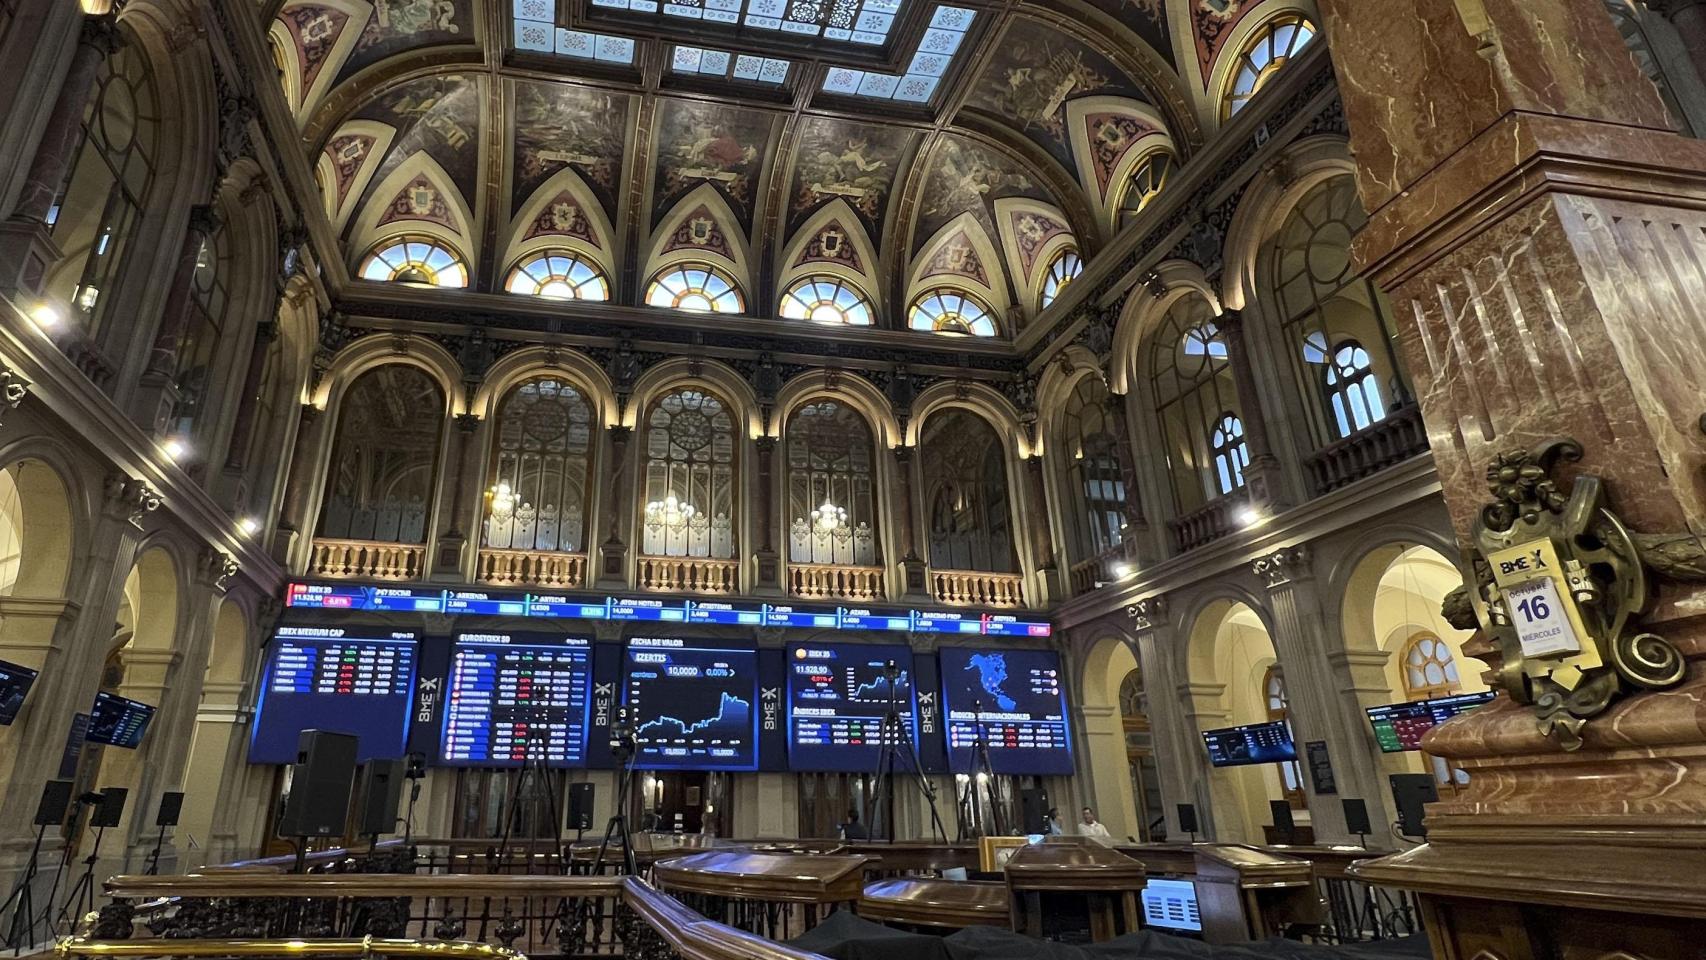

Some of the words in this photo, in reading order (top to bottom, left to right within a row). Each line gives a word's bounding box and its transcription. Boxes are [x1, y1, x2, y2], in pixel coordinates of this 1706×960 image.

[1500, 556, 1530, 574] BME
[1509, 583, 1548, 598] OCTUBRE
[1517, 595, 1550, 622] 16
[279, 627, 297, 636] IBEX
[297, 628, 328, 637] MEDIUM
[329, 629, 345, 638] CAP
[460, 633, 501, 643] EUROSTOXX
[630, 638, 651, 646] FICHA
[662, 639, 684, 647] VALOR
[418, 693, 433, 722] BME
[595, 698, 608, 726] BME
[619, 708, 627, 718] 3
[764, 702, 775, 730] BME
[921, 706, 933, 733] BME
